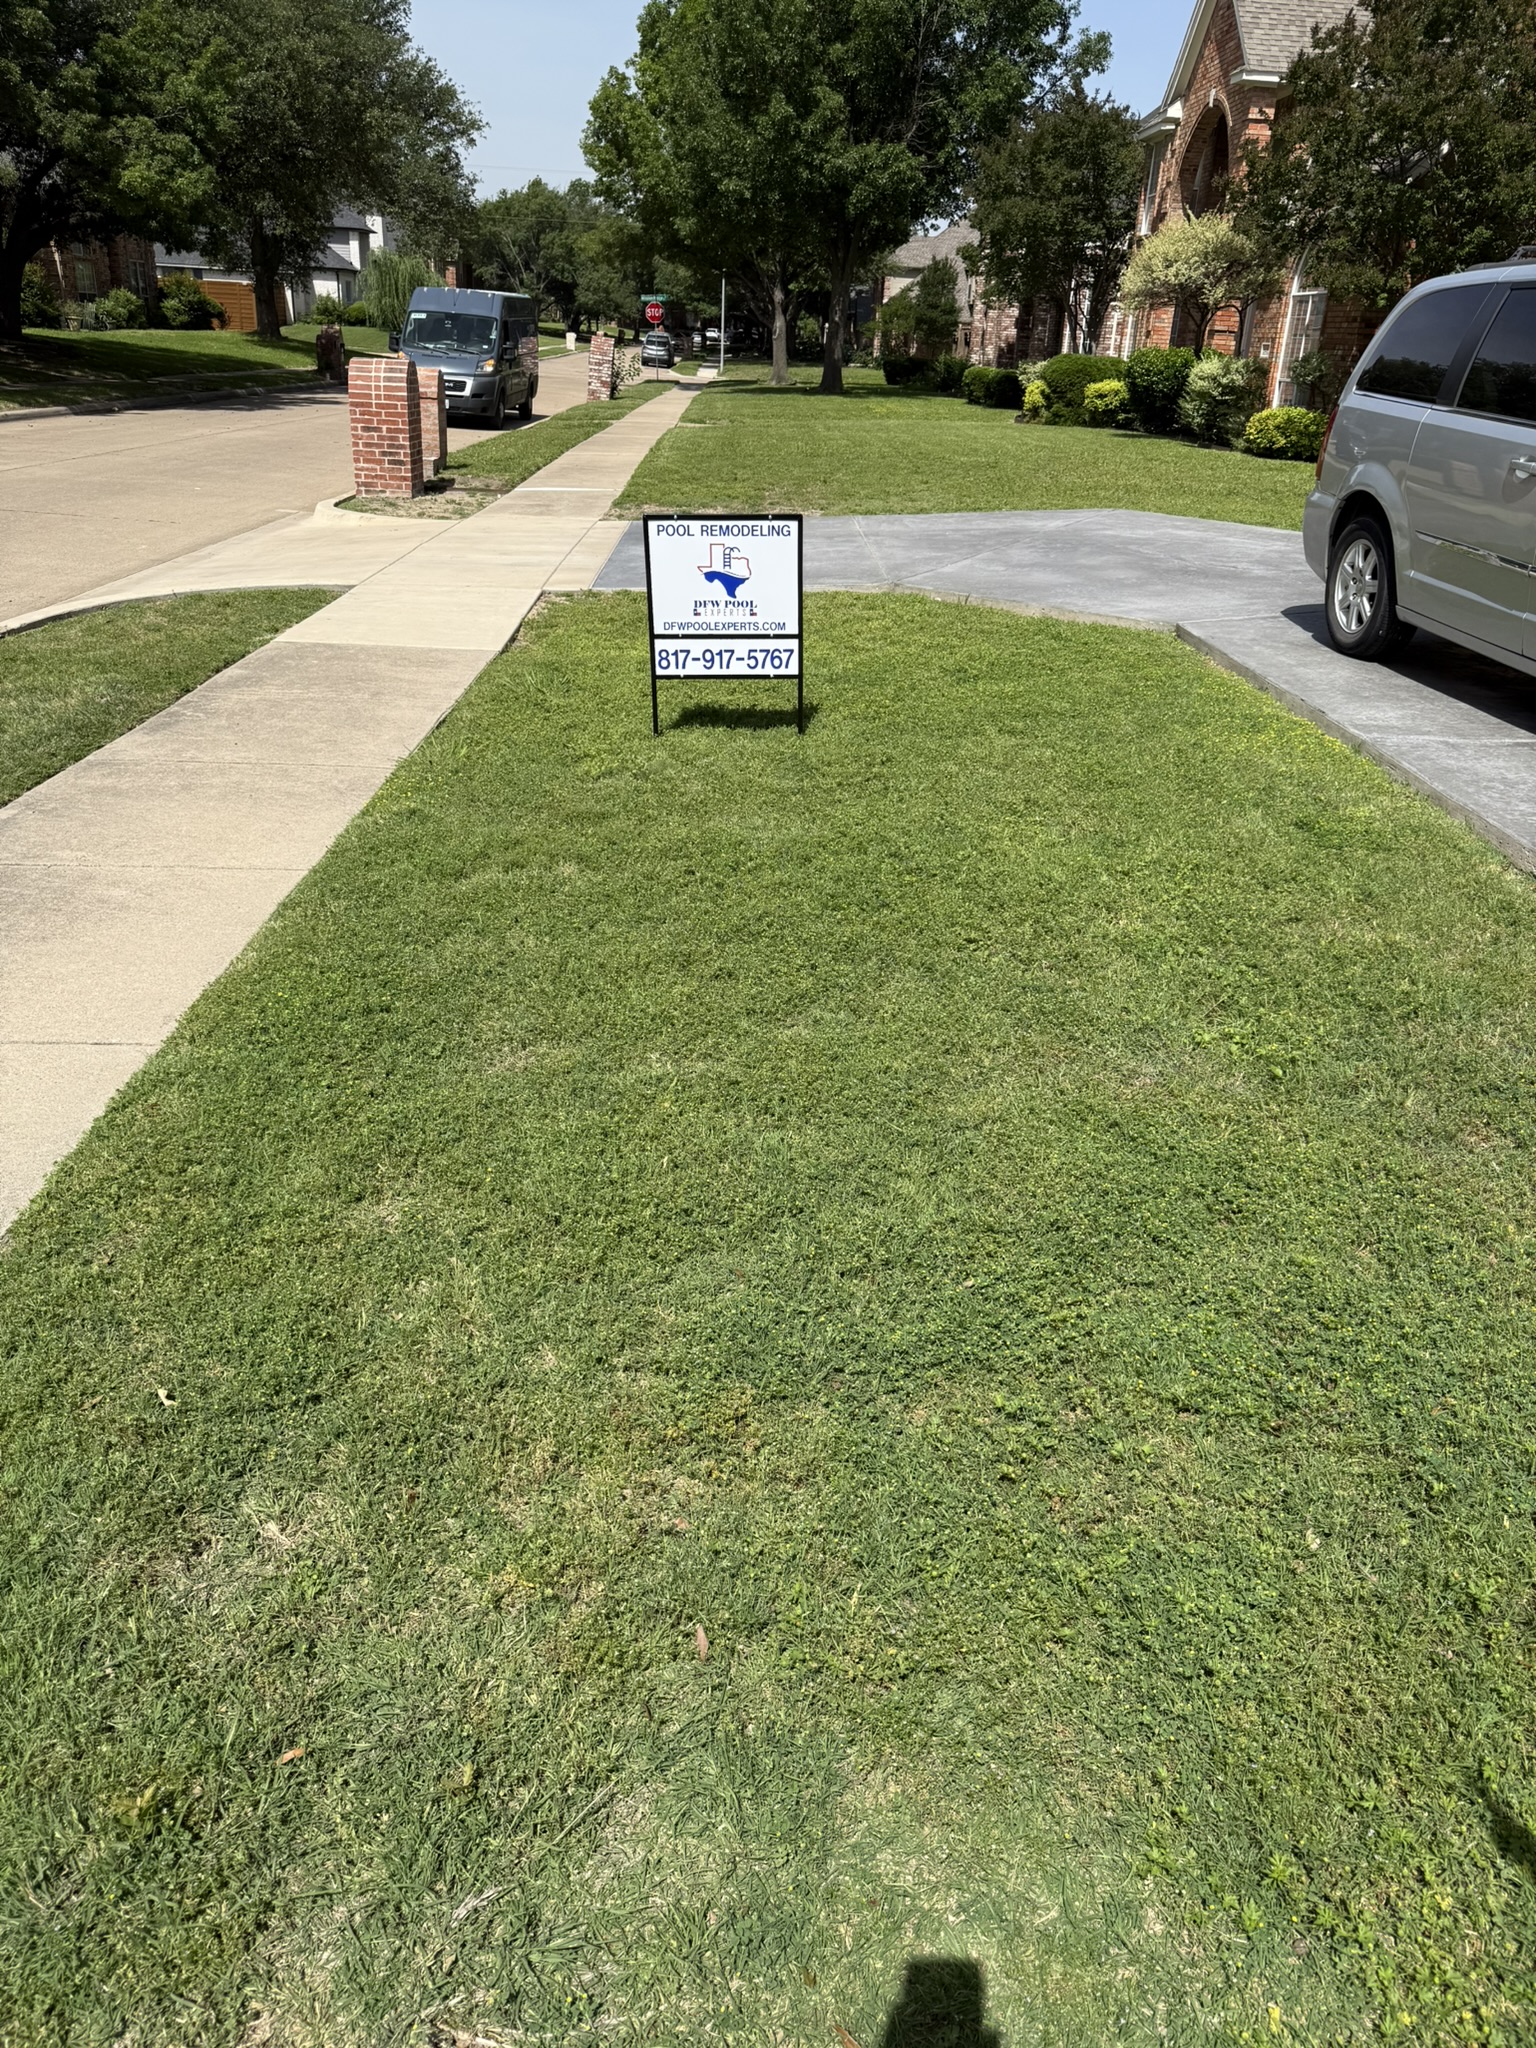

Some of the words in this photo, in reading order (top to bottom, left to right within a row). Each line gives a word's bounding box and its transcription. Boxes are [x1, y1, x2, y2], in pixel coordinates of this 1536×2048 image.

[647, 308, 664, 316] STOP
[656, 524, 695, 537] POOL
[700, 524, 791, 537] REMODELING
[694, 600, 721, 608] DFW
[725, 600, 758, 608] POOL
[704, 608, 747, 616] EXPERTS
[663, 621, 786, 631] DFWPOOLEXPERTS.COM
[658, 649, 795, 670] 817-917-5767
